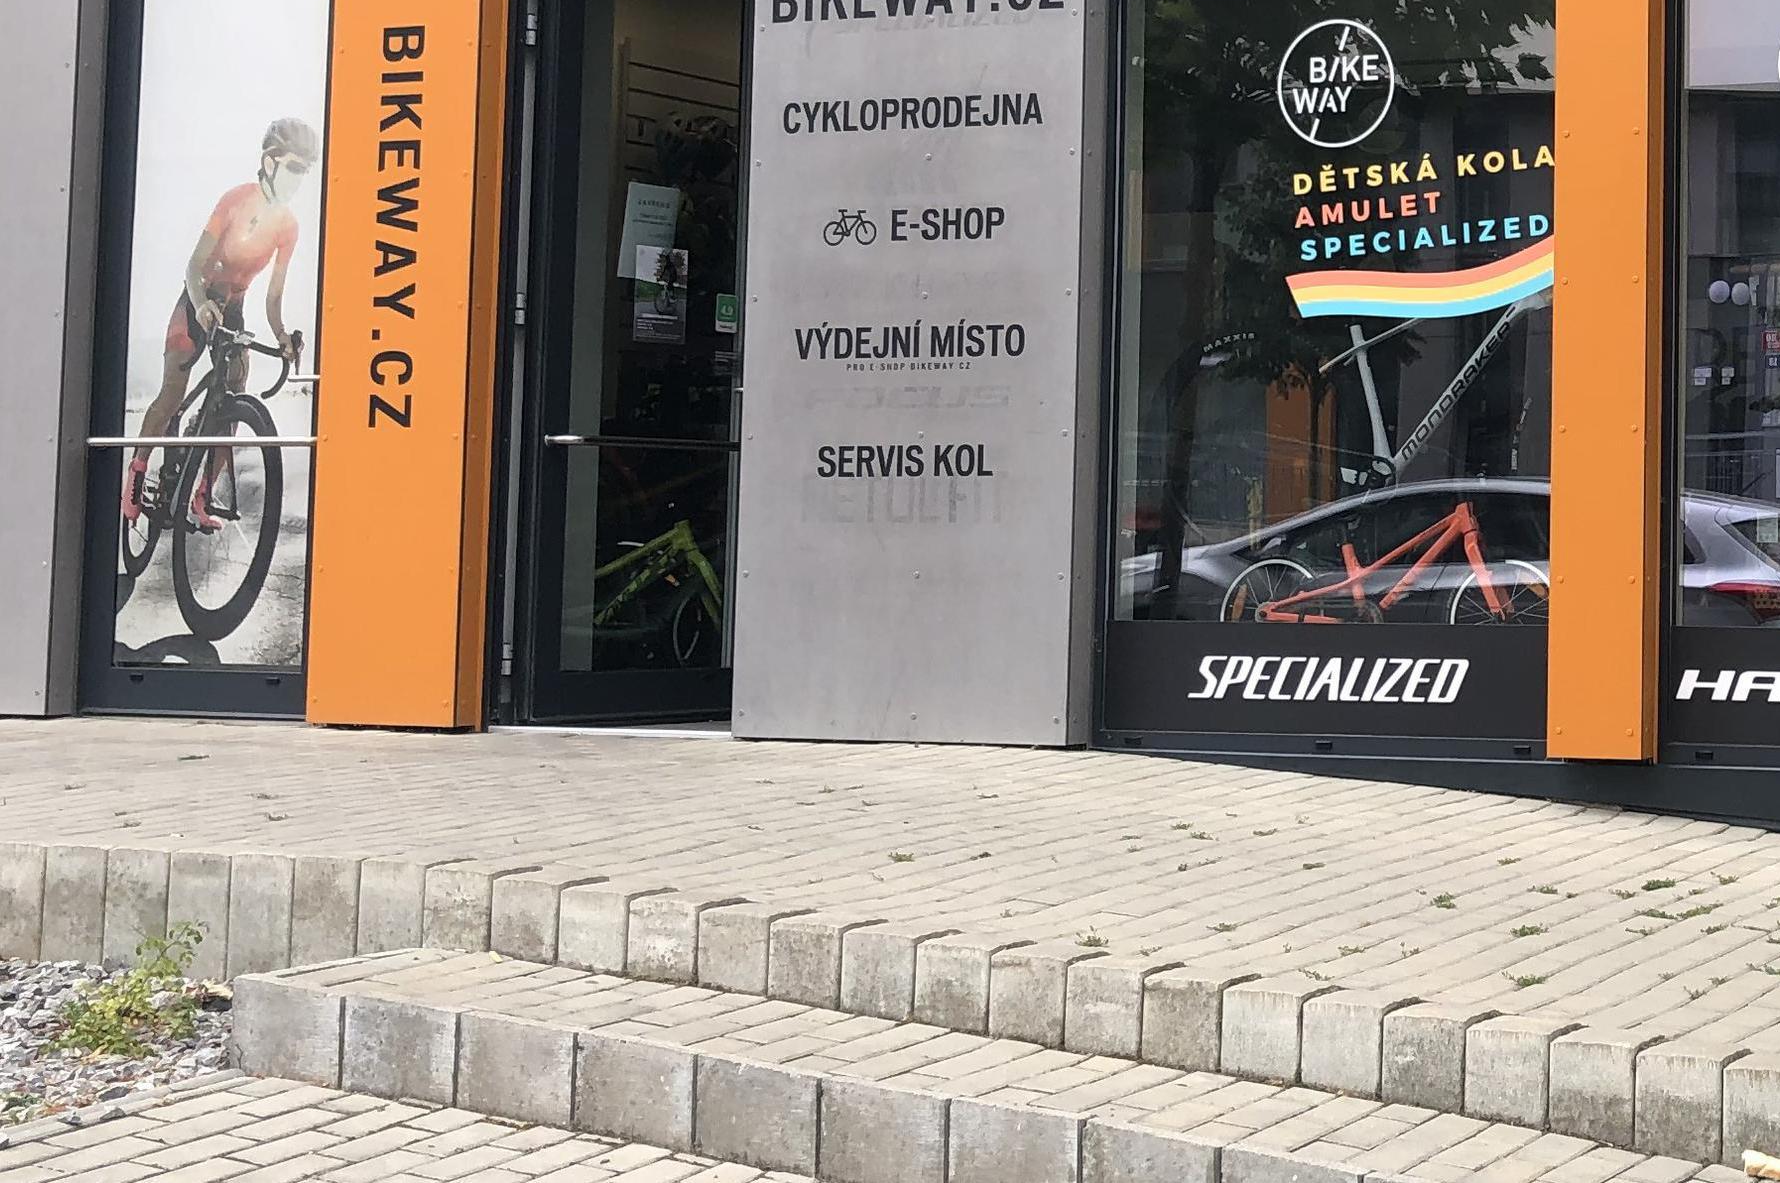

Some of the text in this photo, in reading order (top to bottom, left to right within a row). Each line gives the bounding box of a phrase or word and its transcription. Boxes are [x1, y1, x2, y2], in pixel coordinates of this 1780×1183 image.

[1309, 54, 1379, 83] BIKE
[783, 93, 1043, 134] CYKLOPRODEJNA
[1292, 86, 1352, 114] WAY
[1293, 145, 1555, 195] DĚTSKÁ KOLA
[368, 24, 426, 429] BIKEWAY.CZ
[891, 207, 1005, 241] E-SHOP
[1294, 191, 1441, 228] AMULET
[1300, 214, 1549, 261] SPECIALIZED
[794, 319, 1025, 360] VÝDEJNÍ MÍSTO
[817, 444, 993, 478] SERVIS KOL
[1188, 655, 1469, 704] SPECIALIZED
